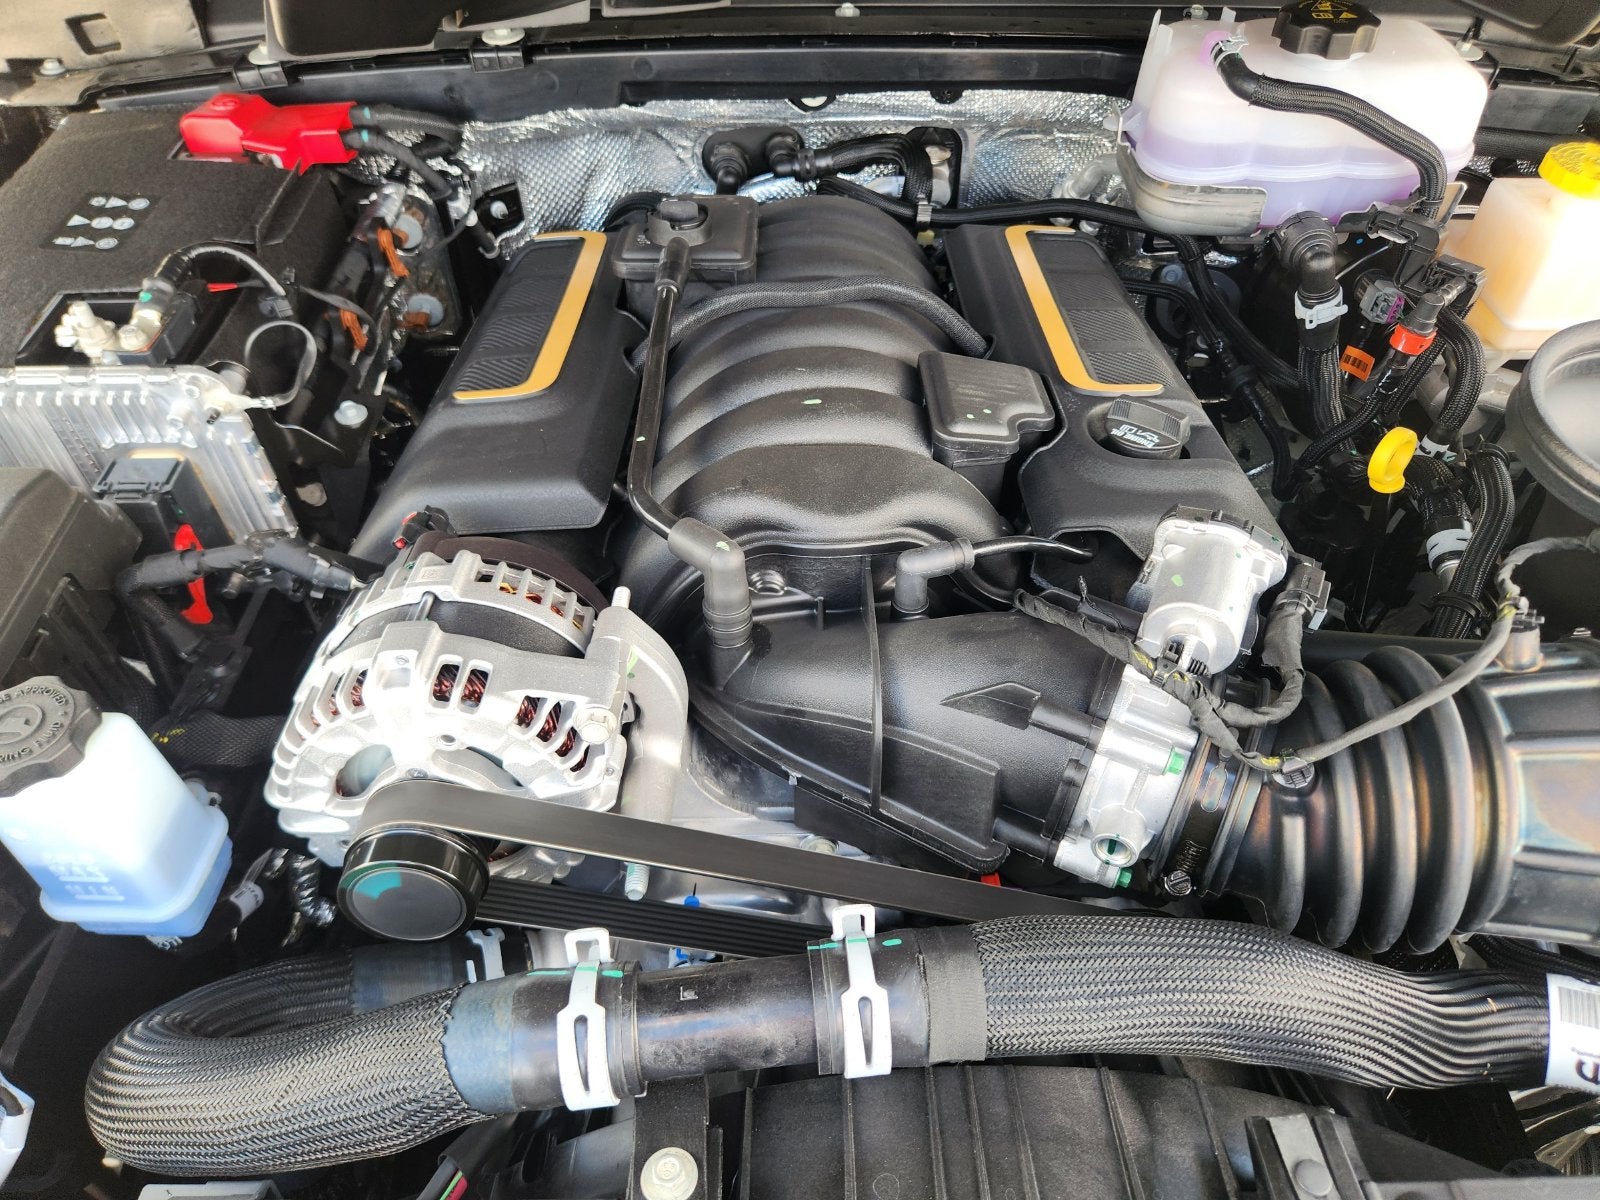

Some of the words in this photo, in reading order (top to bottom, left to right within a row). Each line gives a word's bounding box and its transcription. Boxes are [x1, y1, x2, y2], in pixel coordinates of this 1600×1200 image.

[1110, 428, 1126, 437] OIL
[1123, 432, 1156, 448] ENGINE
[15, 686, 67, 706] APPROVED
[33, 720, 63, 748] FLUID
